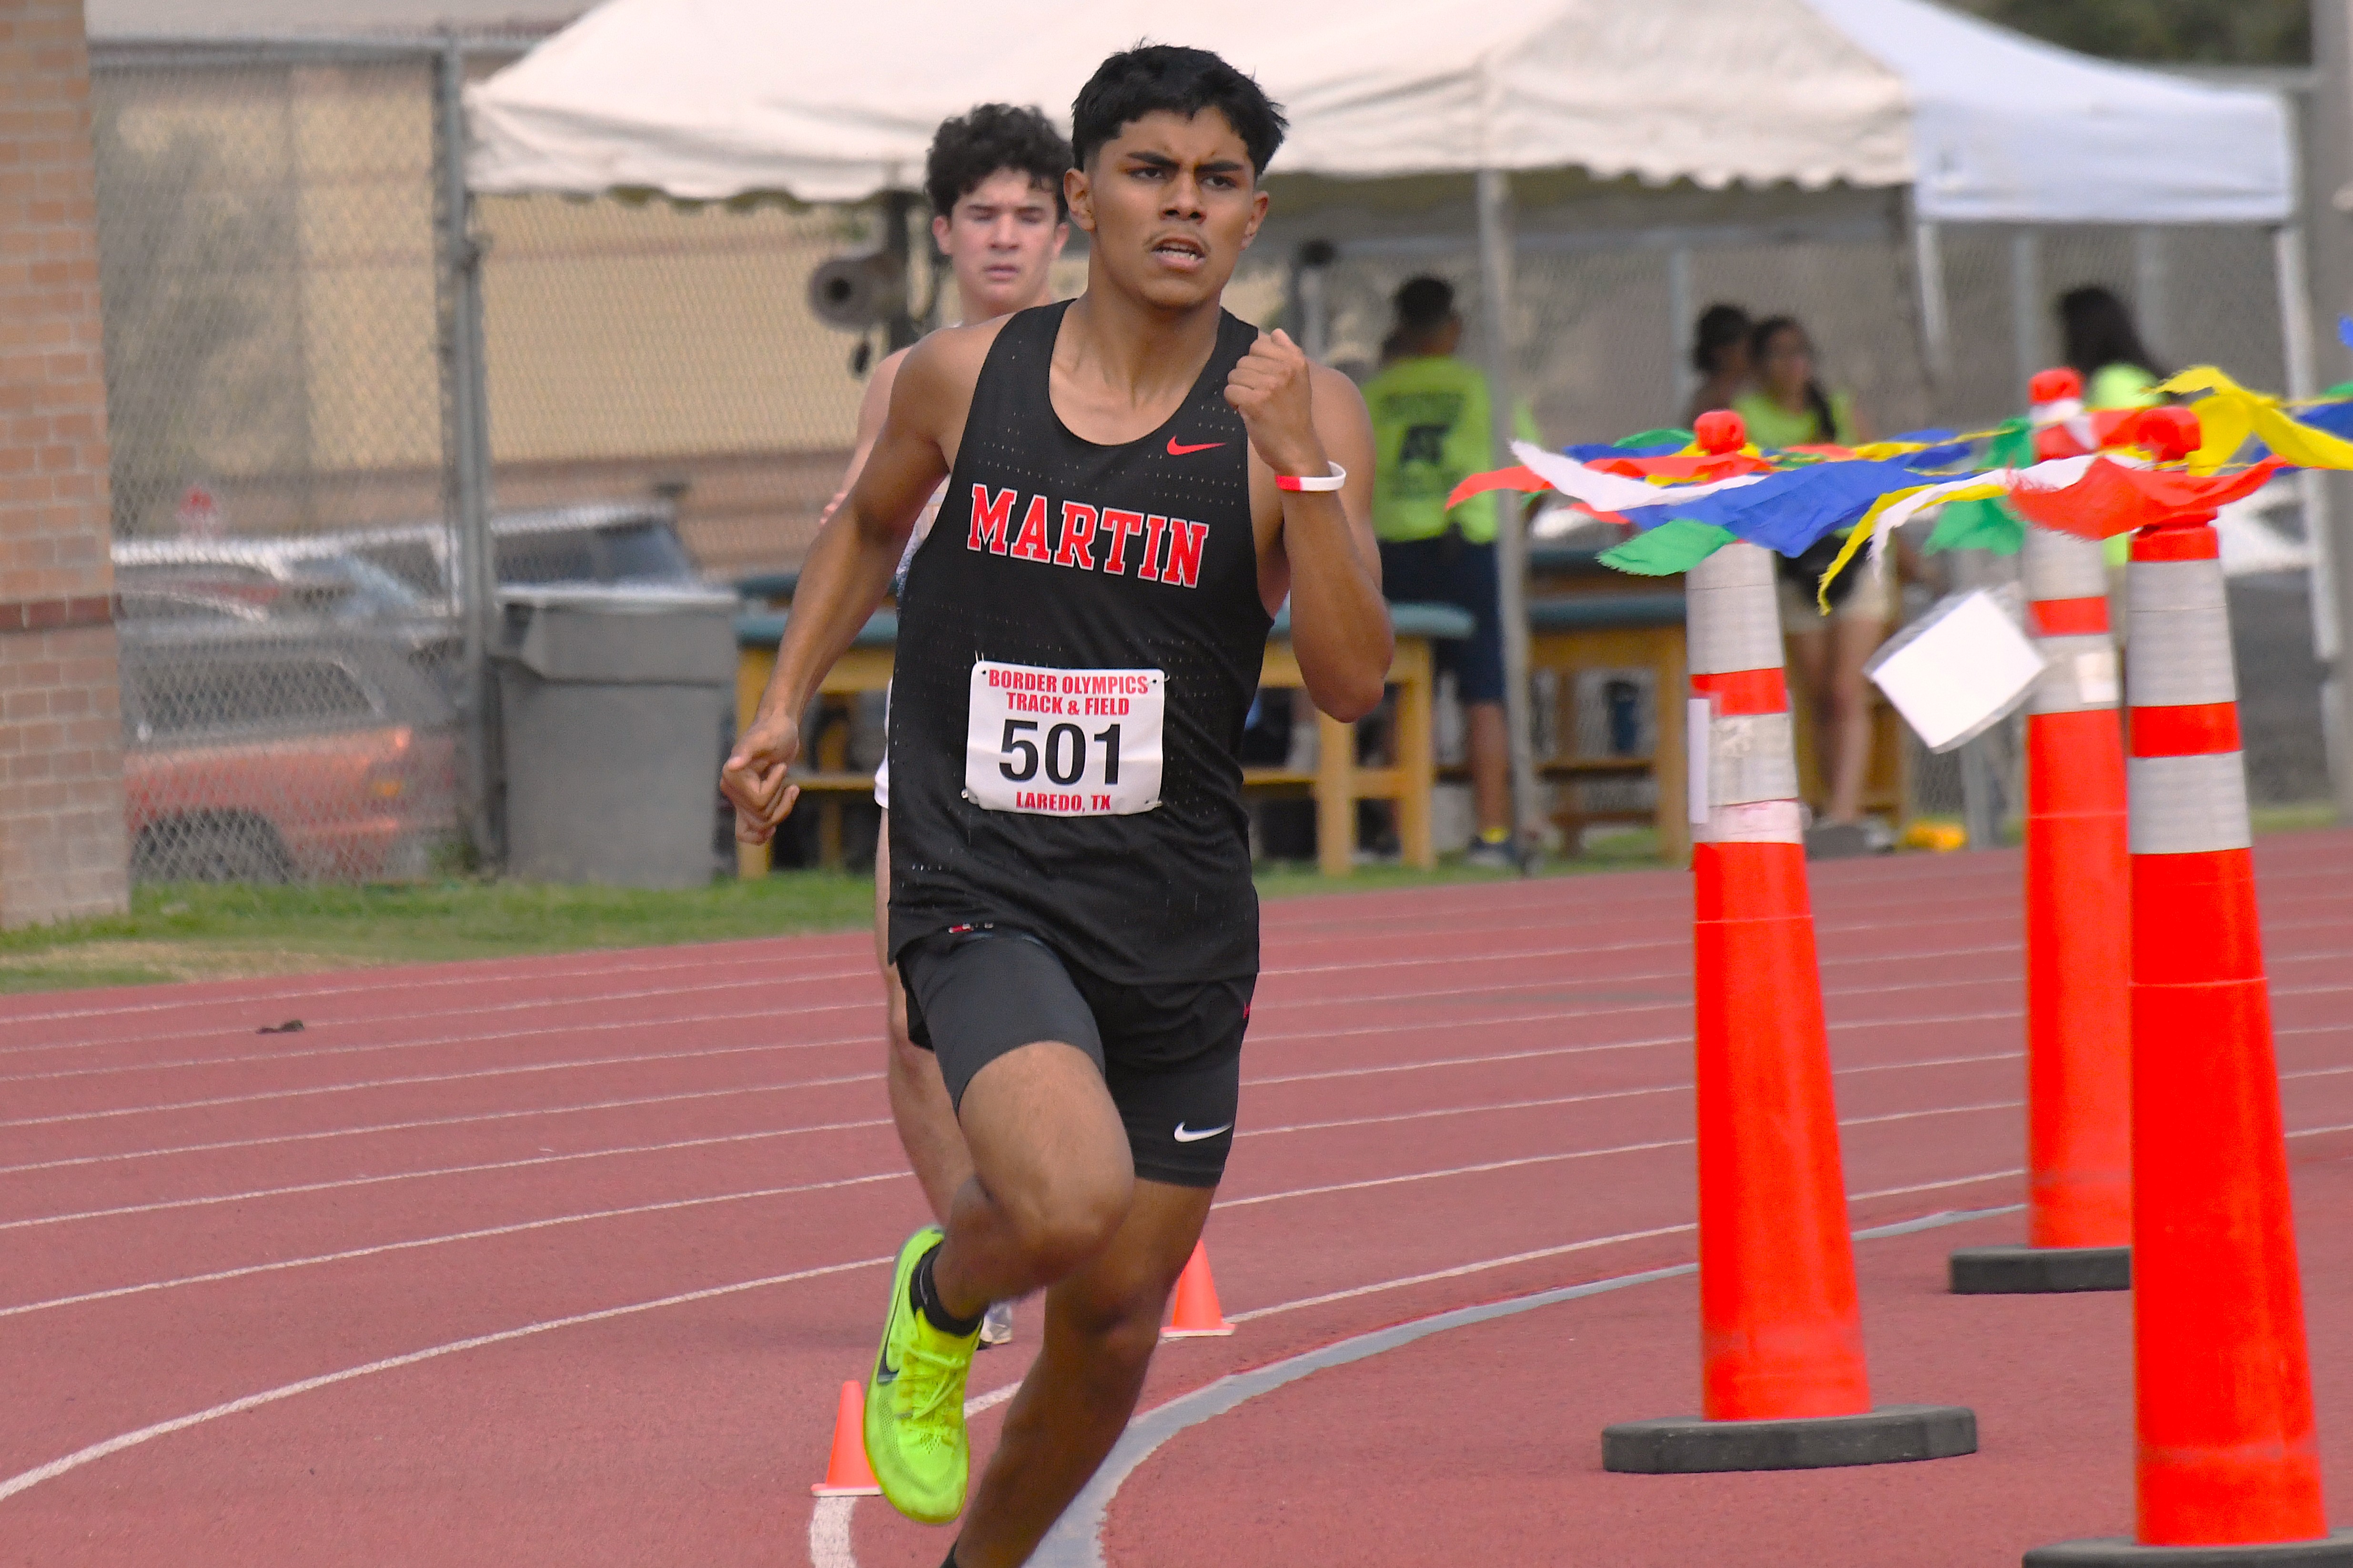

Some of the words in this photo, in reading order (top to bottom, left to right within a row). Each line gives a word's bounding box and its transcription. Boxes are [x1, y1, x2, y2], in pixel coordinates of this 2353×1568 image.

[967, 483, 1210, 589] MARTIN
[989, 669, 1058, 693] BORDER
[1062, 675, 1149, 694] OLYMPICS
[1007, 692, 1063, 714] TRACK
[1067, 700, 1080, 715] &
[1084, 697, 1130, 716] FIELD
[999, 719, 1121, 786] 501
[1016, 791, 1086, 812] LAREDO,
[1091, 794, 1111, 811] TX
